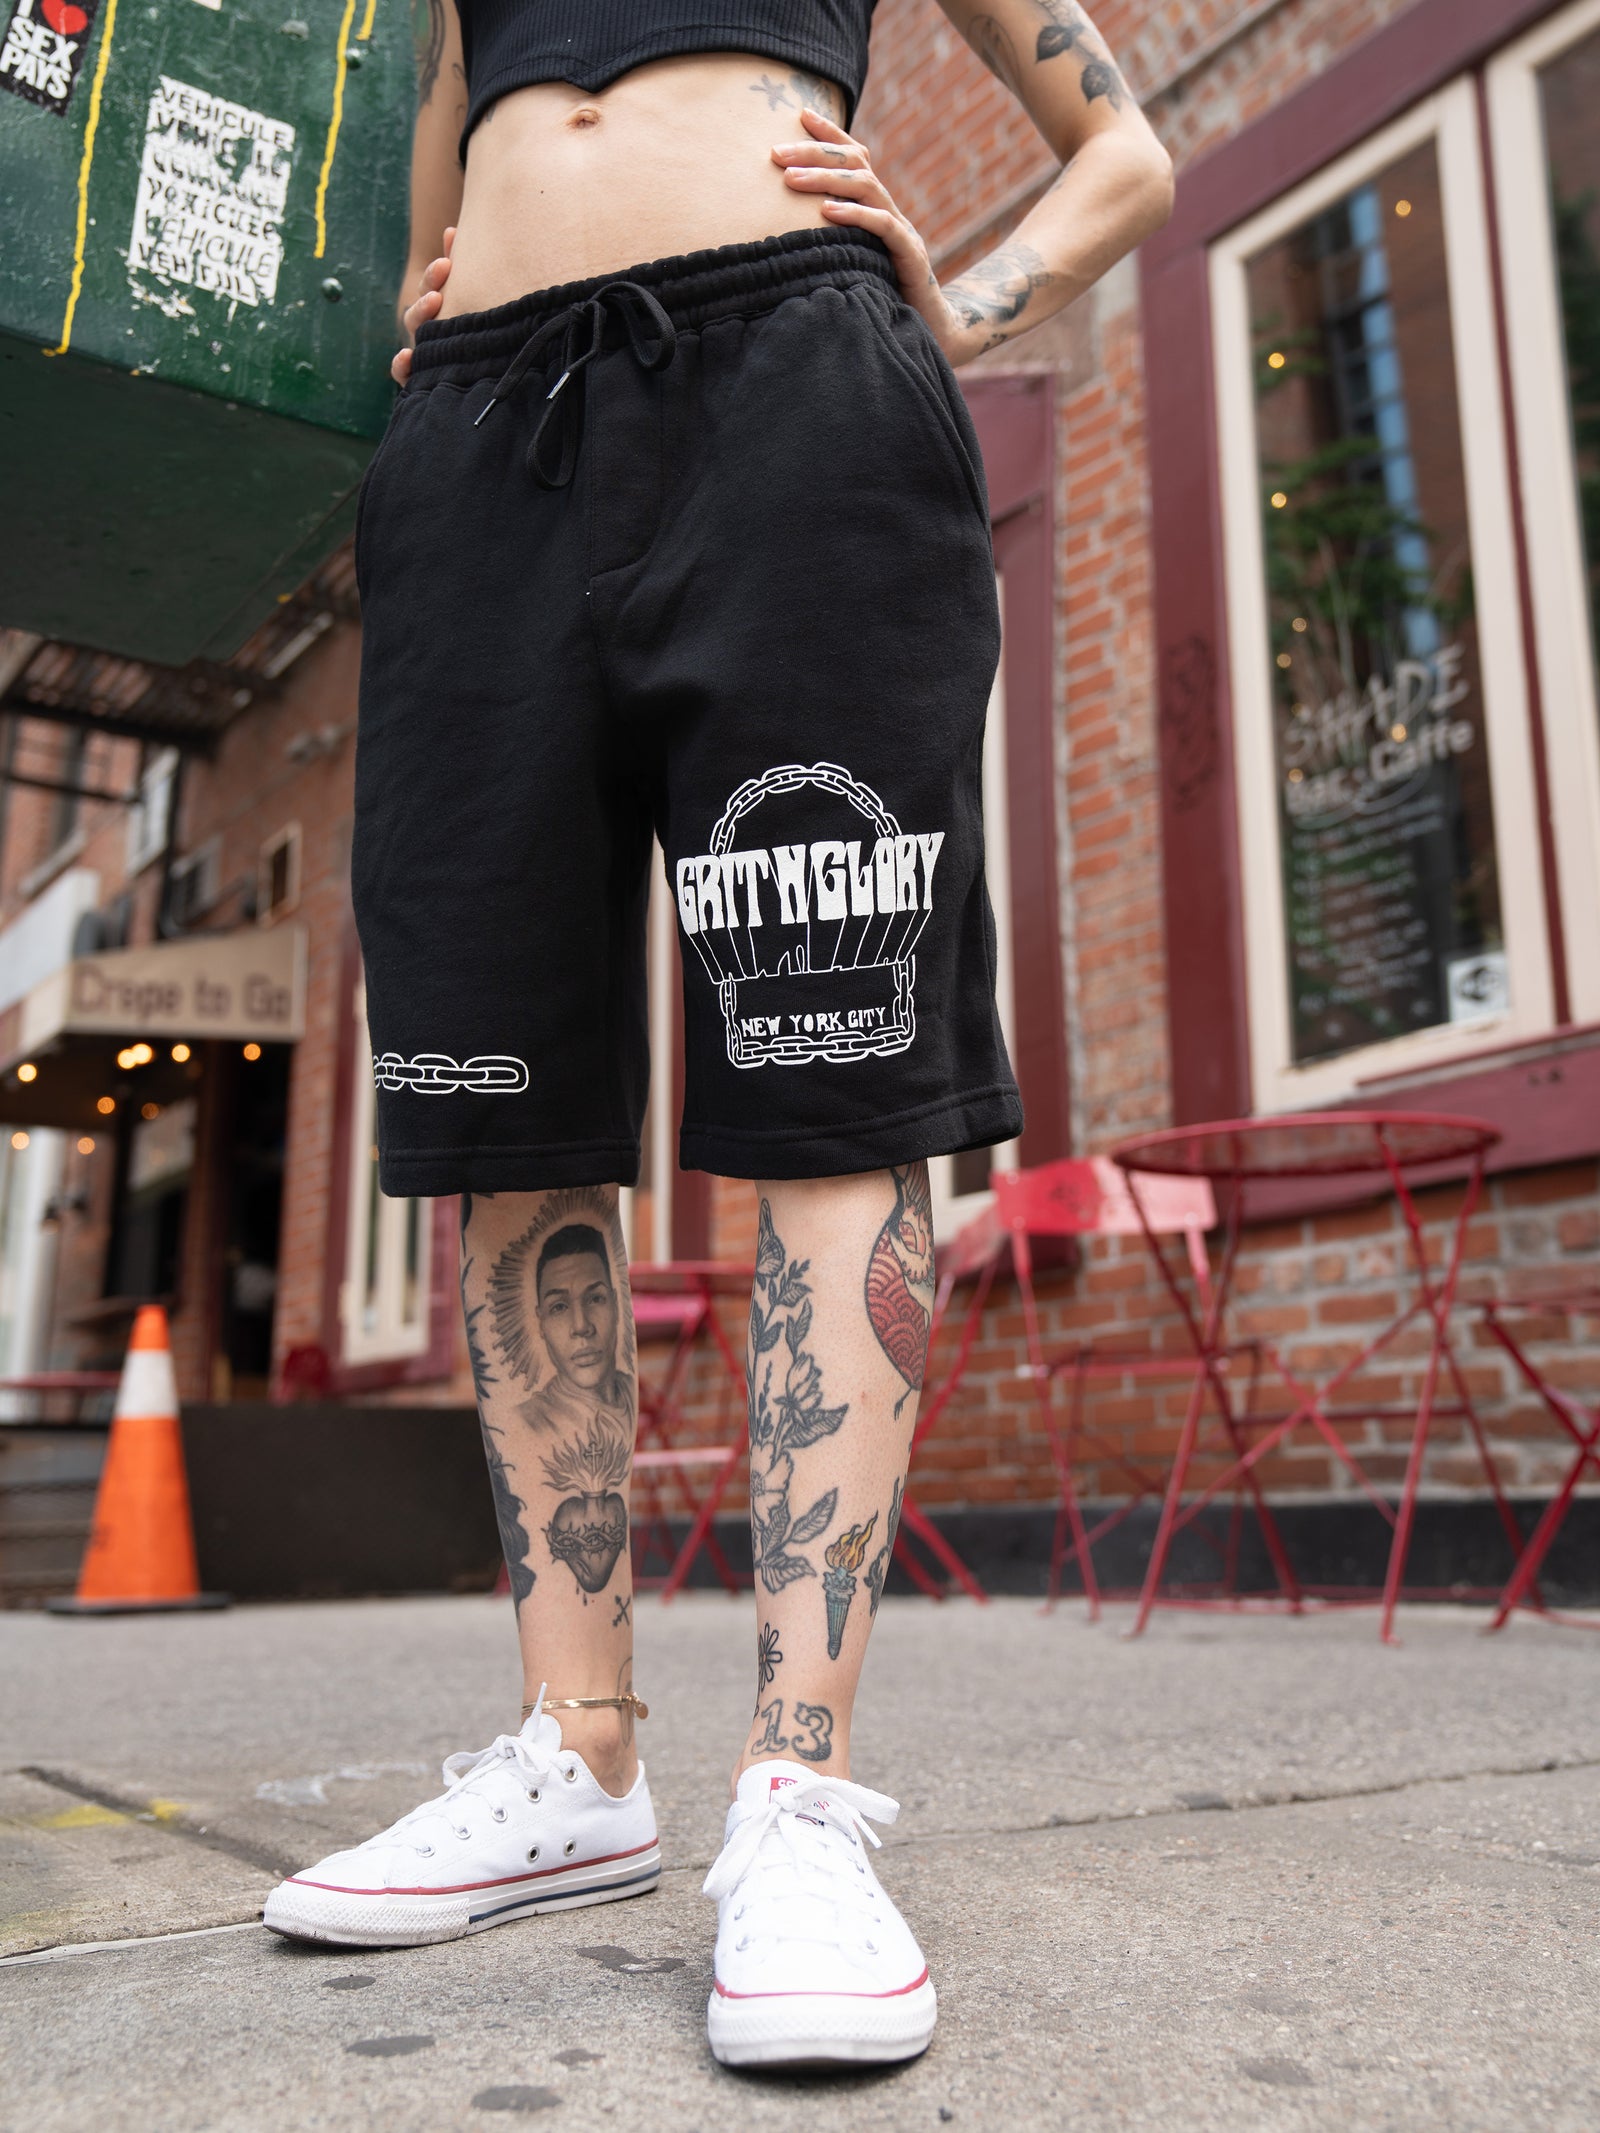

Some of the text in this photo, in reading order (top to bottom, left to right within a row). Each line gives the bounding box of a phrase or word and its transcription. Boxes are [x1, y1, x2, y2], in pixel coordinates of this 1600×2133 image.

[0, 41, 71, 99] PAYS
[7, 15, 79, 72] SEX
[676, 849, 769, 934] GRIT
[810, 831, 946, 921] GLORY
[71, 962, 293, 1025] Crepe to Go
[740, 1006, 886, 1038] NEW YORK CITY
[751, 1698, 834, 1762] 13
